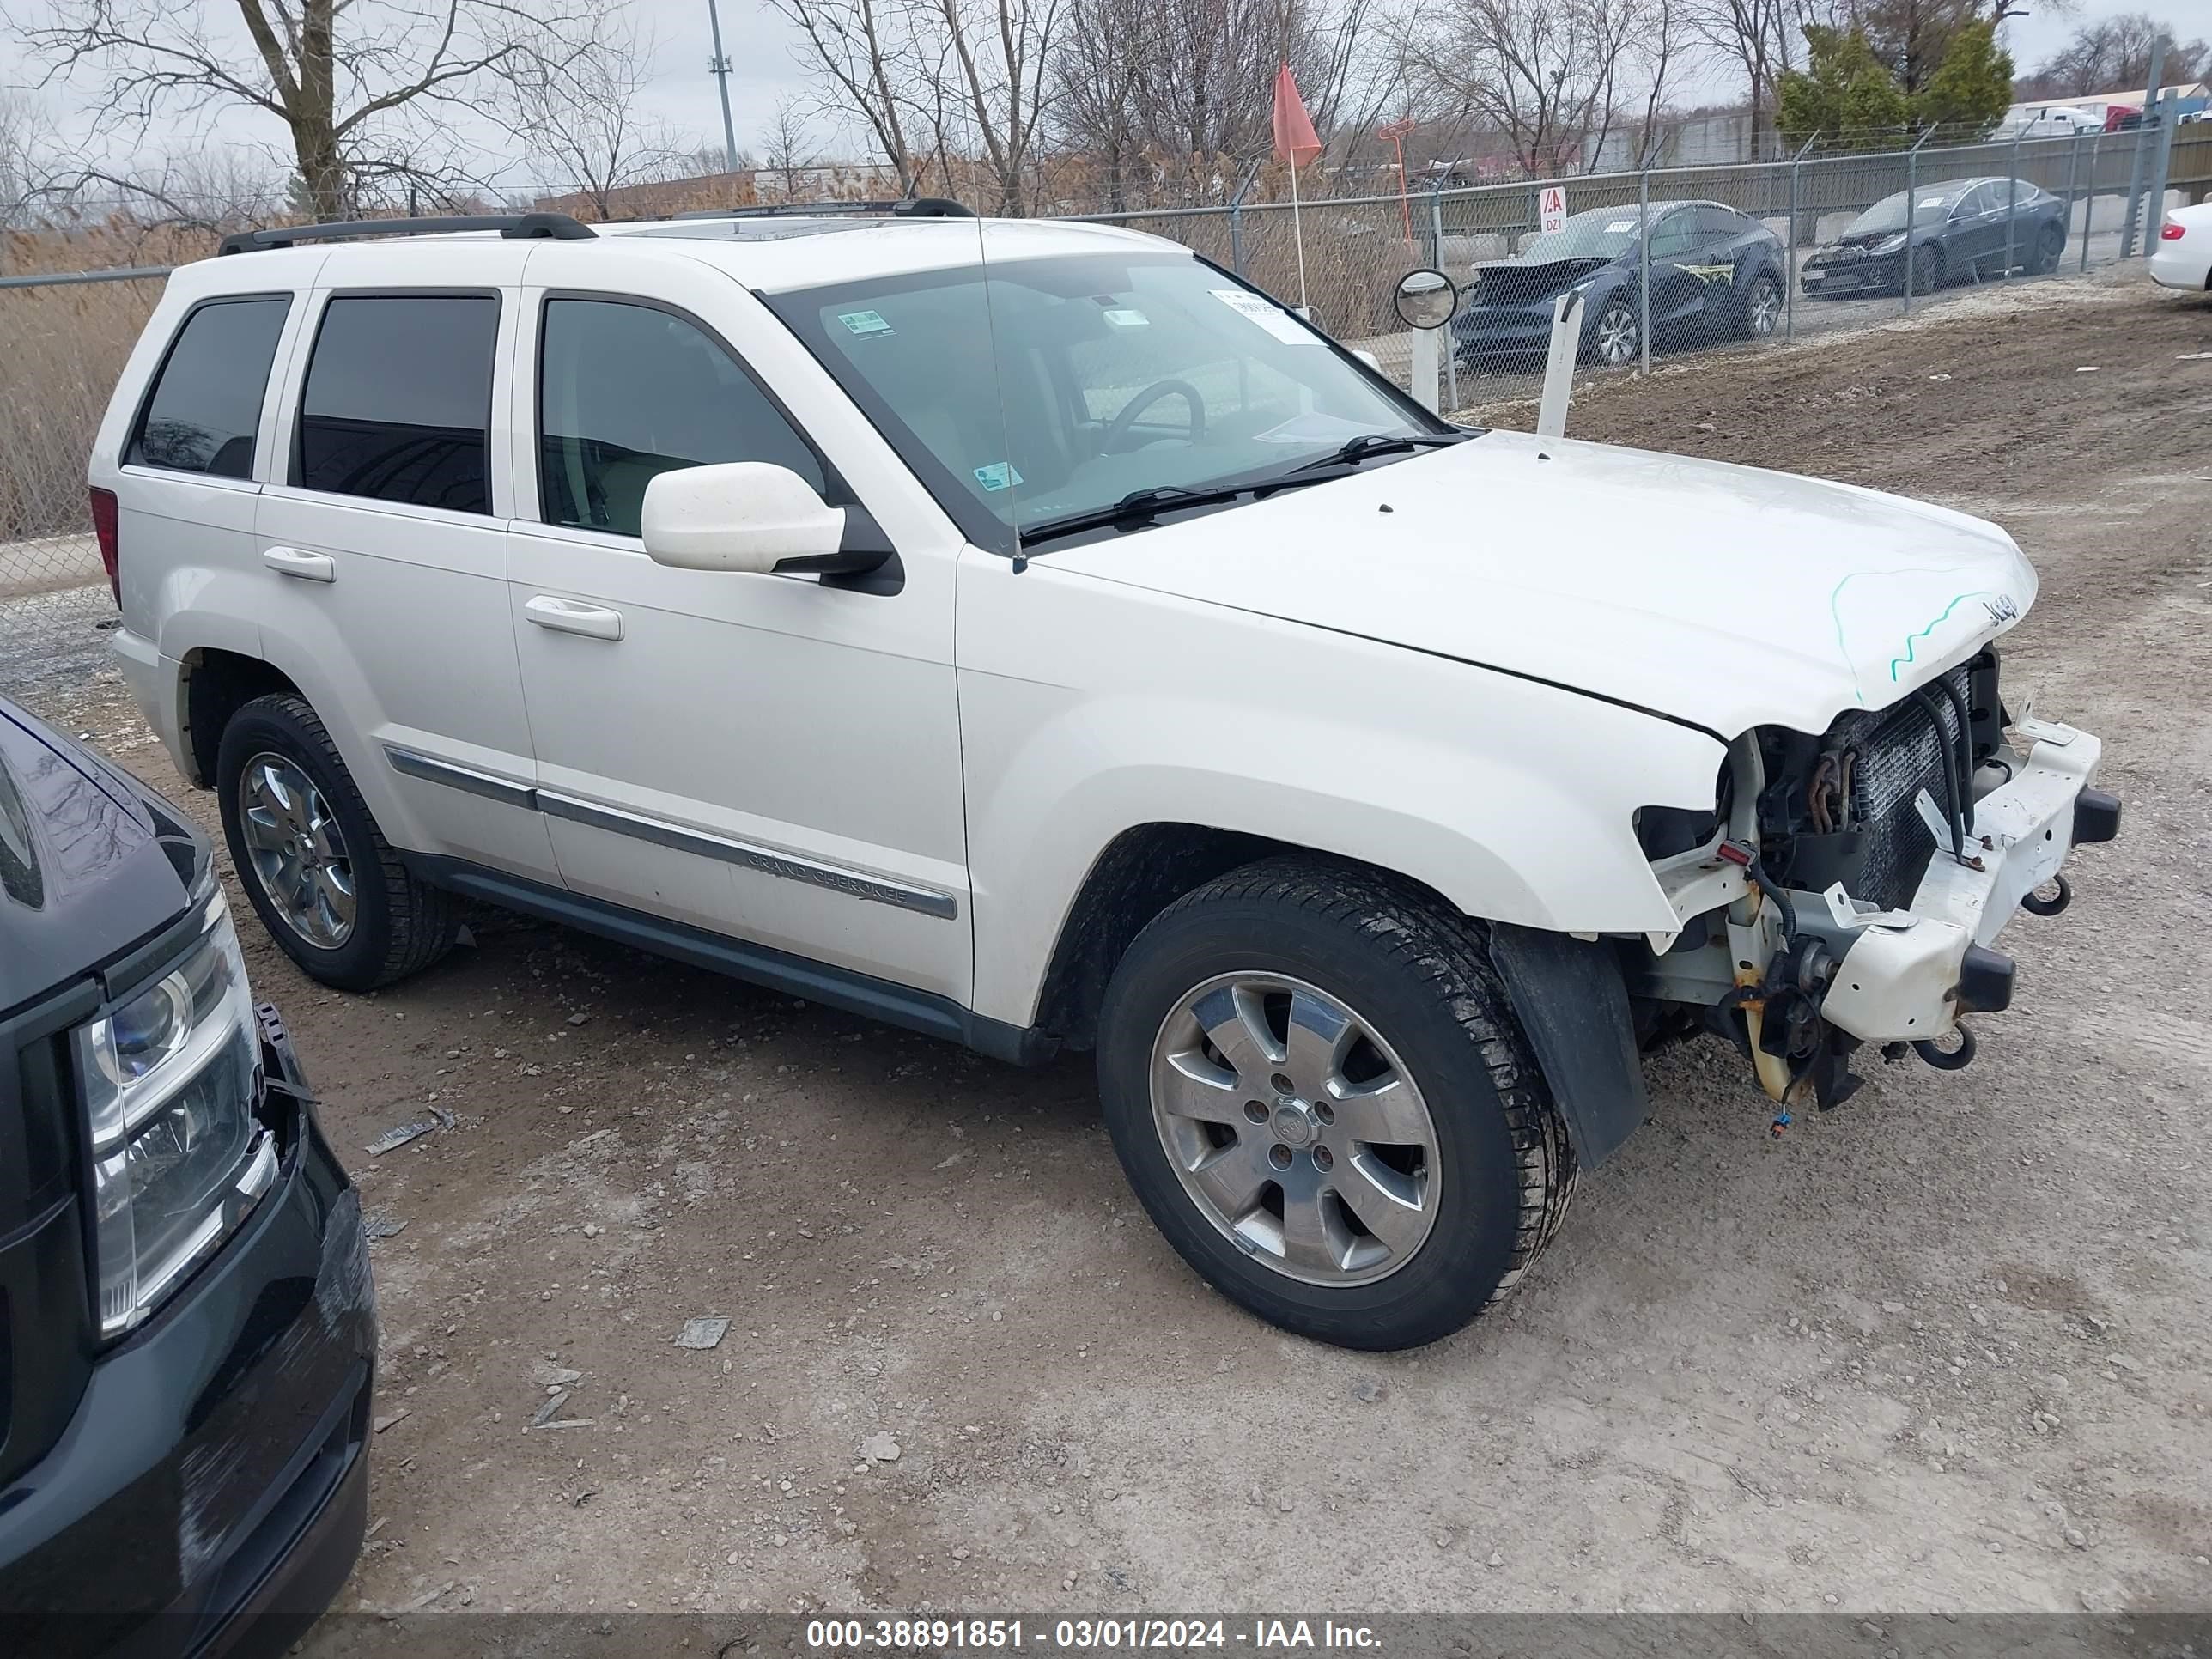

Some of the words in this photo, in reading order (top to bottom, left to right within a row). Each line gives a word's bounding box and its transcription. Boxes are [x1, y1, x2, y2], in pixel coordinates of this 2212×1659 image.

[1547, 219, 1561, 231] DZ1
[1983, 594, 2019, 627] Jeep
[748, 854, 807, 878] GRAND
[812, 871, 908, 904] CHEROKEE
